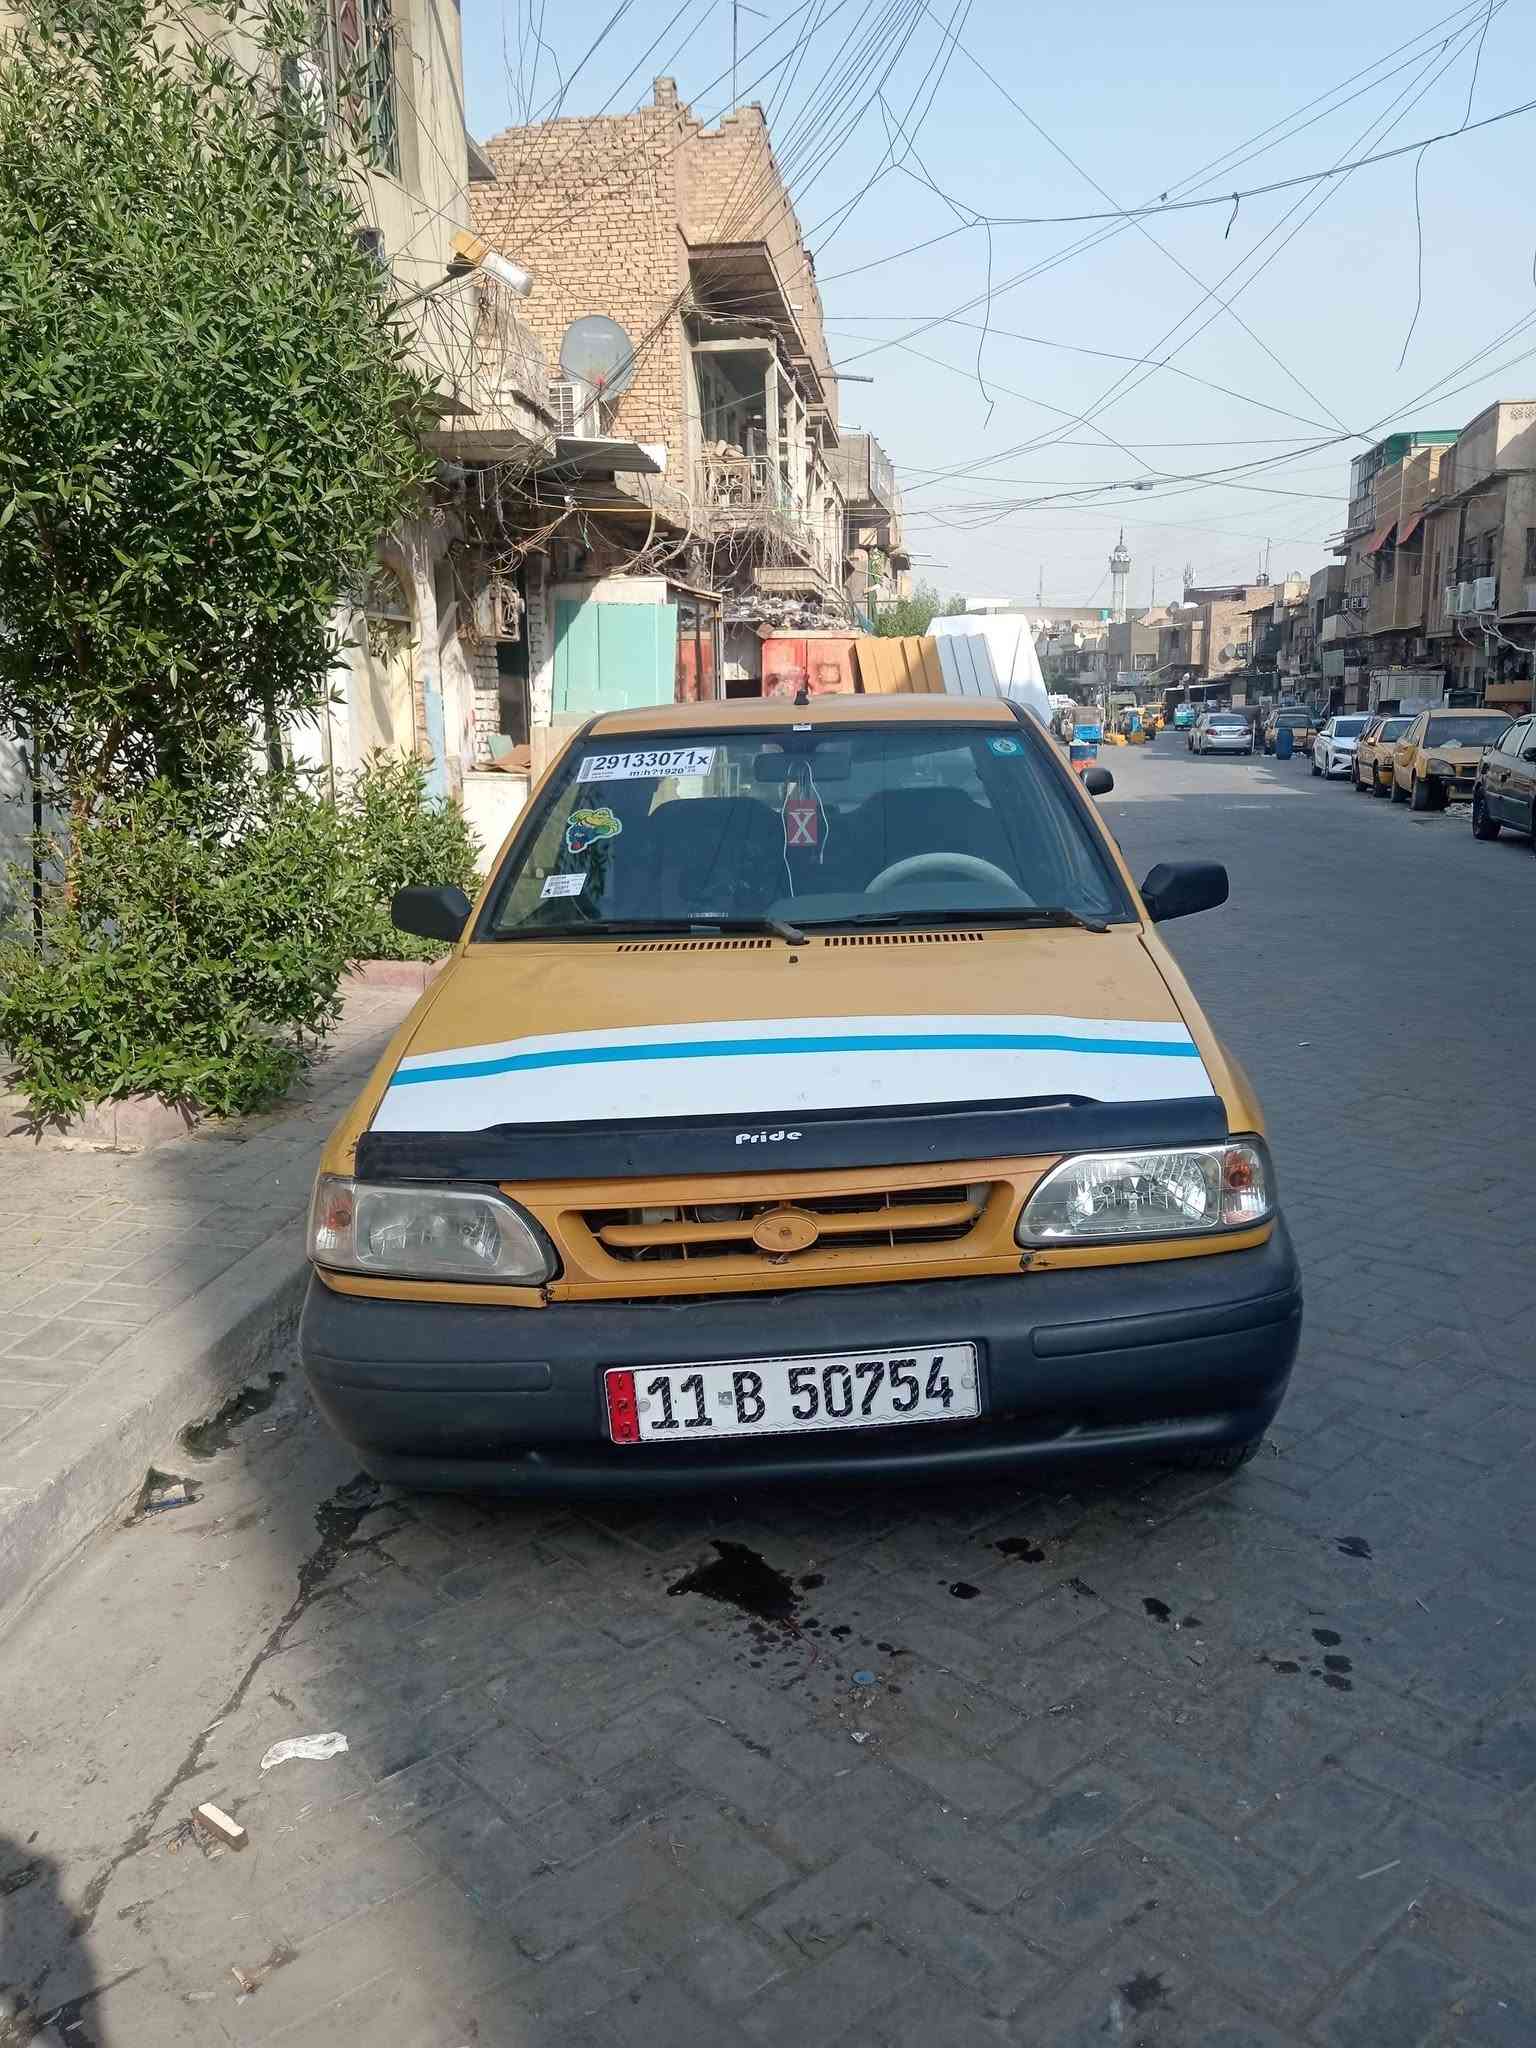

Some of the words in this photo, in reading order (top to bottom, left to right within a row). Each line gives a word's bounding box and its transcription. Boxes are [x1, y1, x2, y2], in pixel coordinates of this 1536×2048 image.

[593, 751, 709, 770] 29133071x
[736, 1131, 802, 1144] Pride
[647, 1374, 712, 1429] 11
[733, 1371, 765, 1423] B
[788, 1356, 953, 1419] 50754
